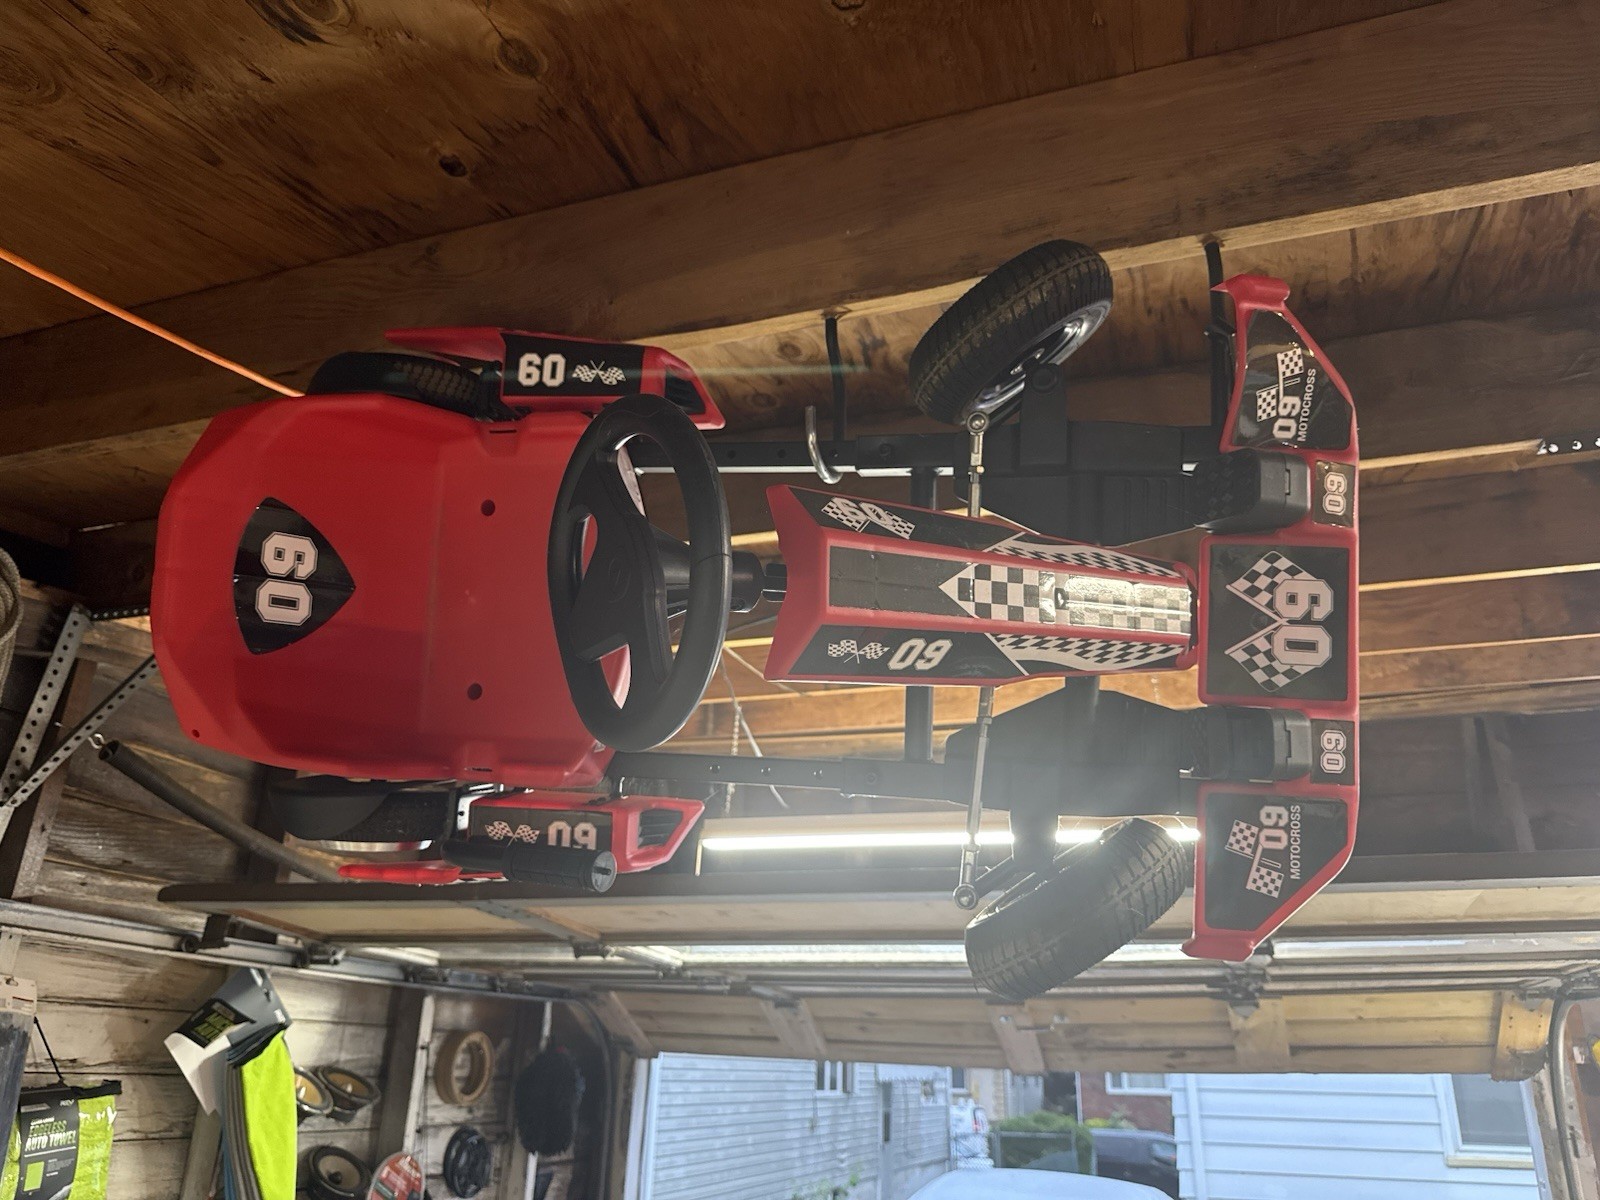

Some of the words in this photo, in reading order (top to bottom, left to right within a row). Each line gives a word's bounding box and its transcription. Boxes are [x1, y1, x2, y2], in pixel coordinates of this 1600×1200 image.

[1272, 396, 1301, 439] 09
[1297, 368, 1316, 442] MOTOCROSS
[1322, 472, 1347, 515] 09
[255, 531, 318, 626] 09
[1271, 578, 1334, 668] 09
[887, 637, 953, 671] 09
[1320, 729, 1346, 774] 09
[1258, 805, 1289, 850] 09
[1290, 805, 1301, 880] MOTOCROSS
[25, 1134, 48, 1152] AUTO
[49, 1130, 76, 1147] TOWEL
